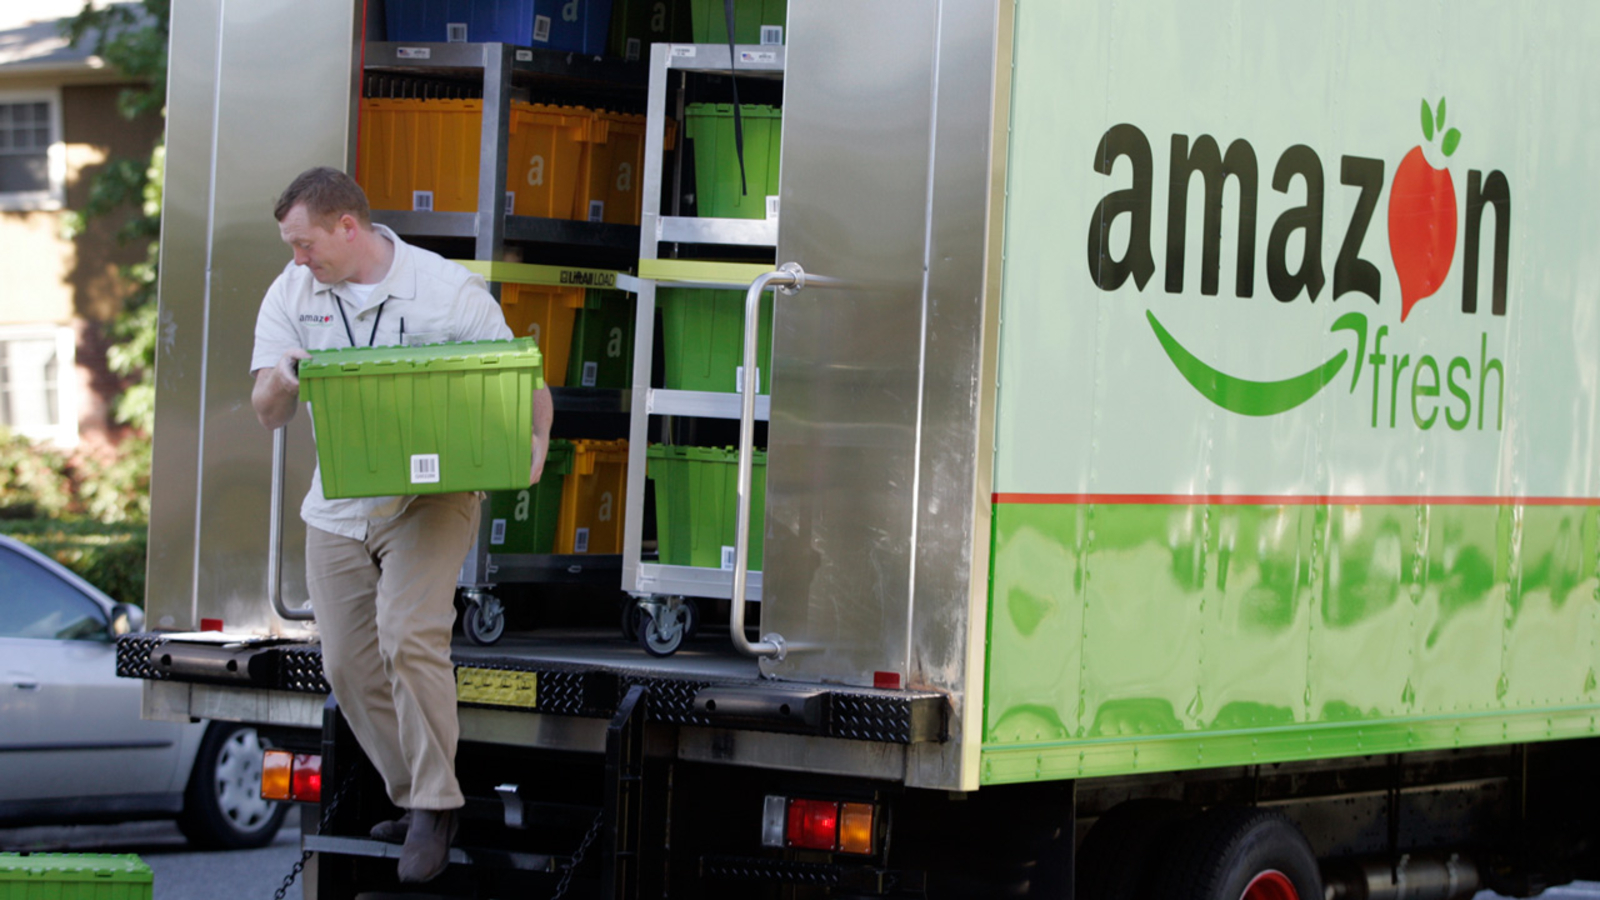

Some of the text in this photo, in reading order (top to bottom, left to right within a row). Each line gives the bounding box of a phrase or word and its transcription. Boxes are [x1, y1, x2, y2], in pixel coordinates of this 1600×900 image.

[651, 2, 666, 33] a
[527, 154, 545, 186] a
[616, 162, 632, 192] a
[1087, 121, 1511, 320] amazon
[299, 314, 334, 323] amazon
[607, 327, 622, 358] a
[1368, 325, 1505, 431] fresh
[514, 489, 530, 521] a
[598, 491, 613, 521] a
